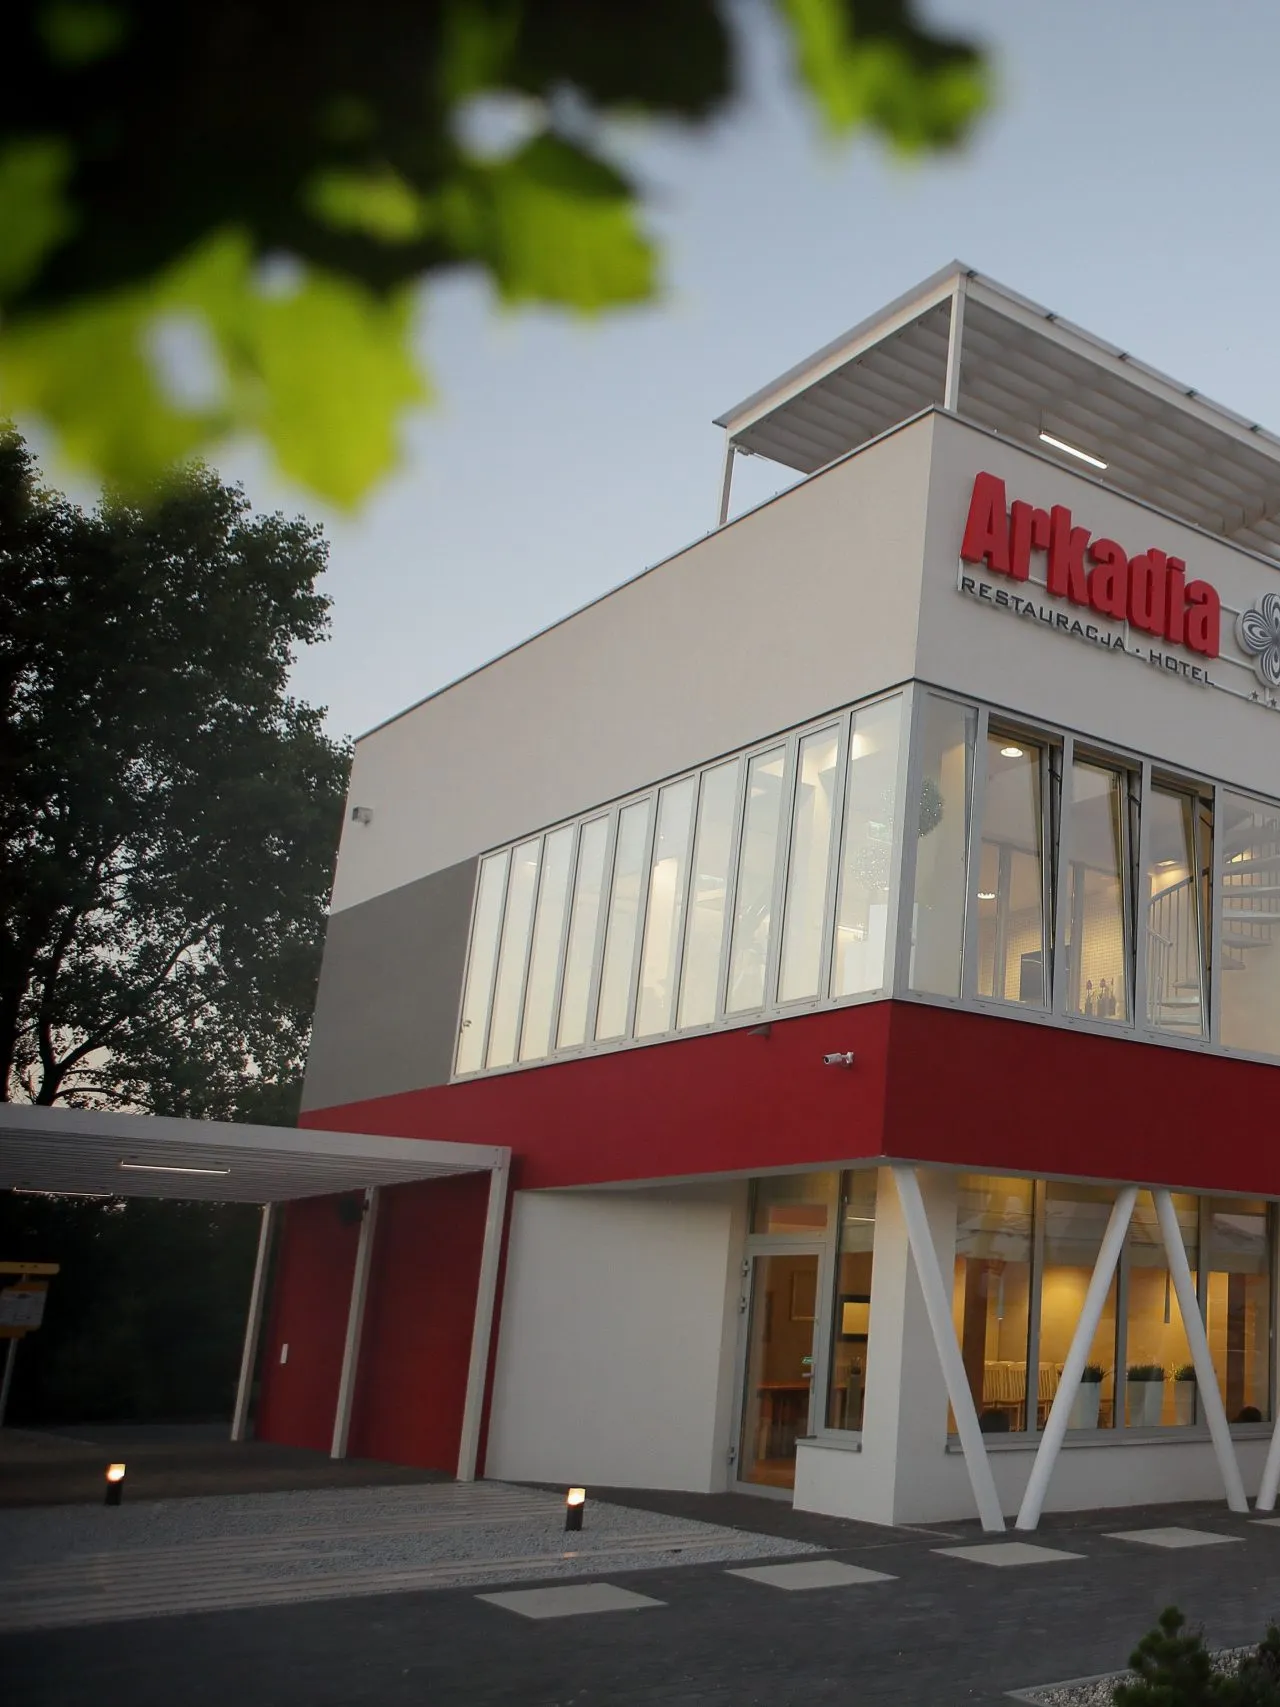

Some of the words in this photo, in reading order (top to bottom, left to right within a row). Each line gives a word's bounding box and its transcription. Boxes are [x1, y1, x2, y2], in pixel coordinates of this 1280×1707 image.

[960, 471, 1221, 659] Arkadia
[961, 576, 1126, 651] RESTAURACJA
[1148, 649, 1215, 686] HOTEL
